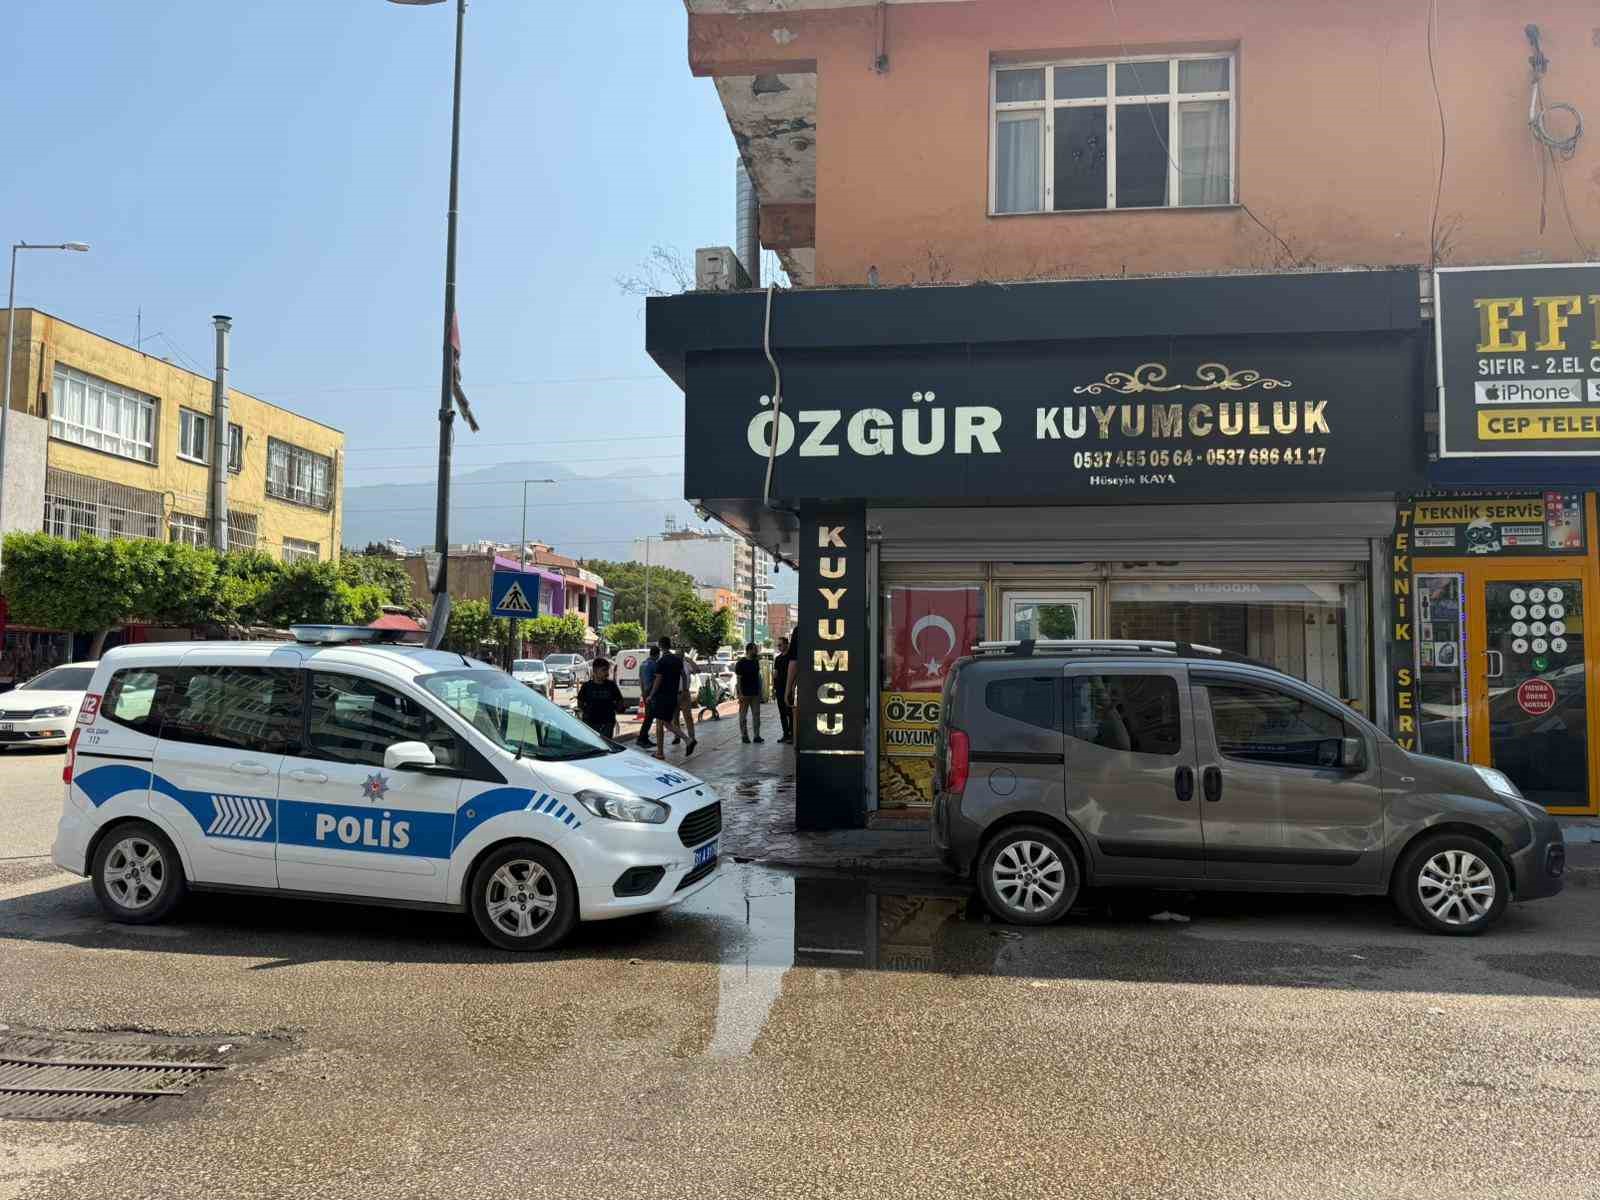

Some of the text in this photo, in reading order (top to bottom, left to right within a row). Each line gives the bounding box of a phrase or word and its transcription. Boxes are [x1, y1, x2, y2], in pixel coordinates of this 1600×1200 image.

[1478, 358, 1526, 375] SIFIR
[1546, 357, 1585, 374] 2.EL
[1502, 384, 1570, 401] iPhone
[747, 391, 1002, 457] ÖZGÜR
[1036, 400, 1331, 440] KUYUMCULUK
[1488, 416, 1600, 433] CEP TELE
[1073, 451, 1113, 469] 0537
[1115, 450, 1146, 467] 455
[1150, 450, 1170, 467] 05
[1173, 449, 1193, 466] 64
[1206, 448, 1245, 466] 0537
[1249, 448, 1279, 465] 686
[1283, 448, 1303, 465] 41
[1307, 448, 1327, 465] 17
[1090, 474, 1177, 487] Hüseyin KAYA
[813, 526, 849, 735] KUYUMCU
[886, 697, 940, 722] ÖZG
[1397, 669, 1414, 750] SERV
[886, 730, 936, 745] KUYUM
[316, 810, 411, 850] POLİS
